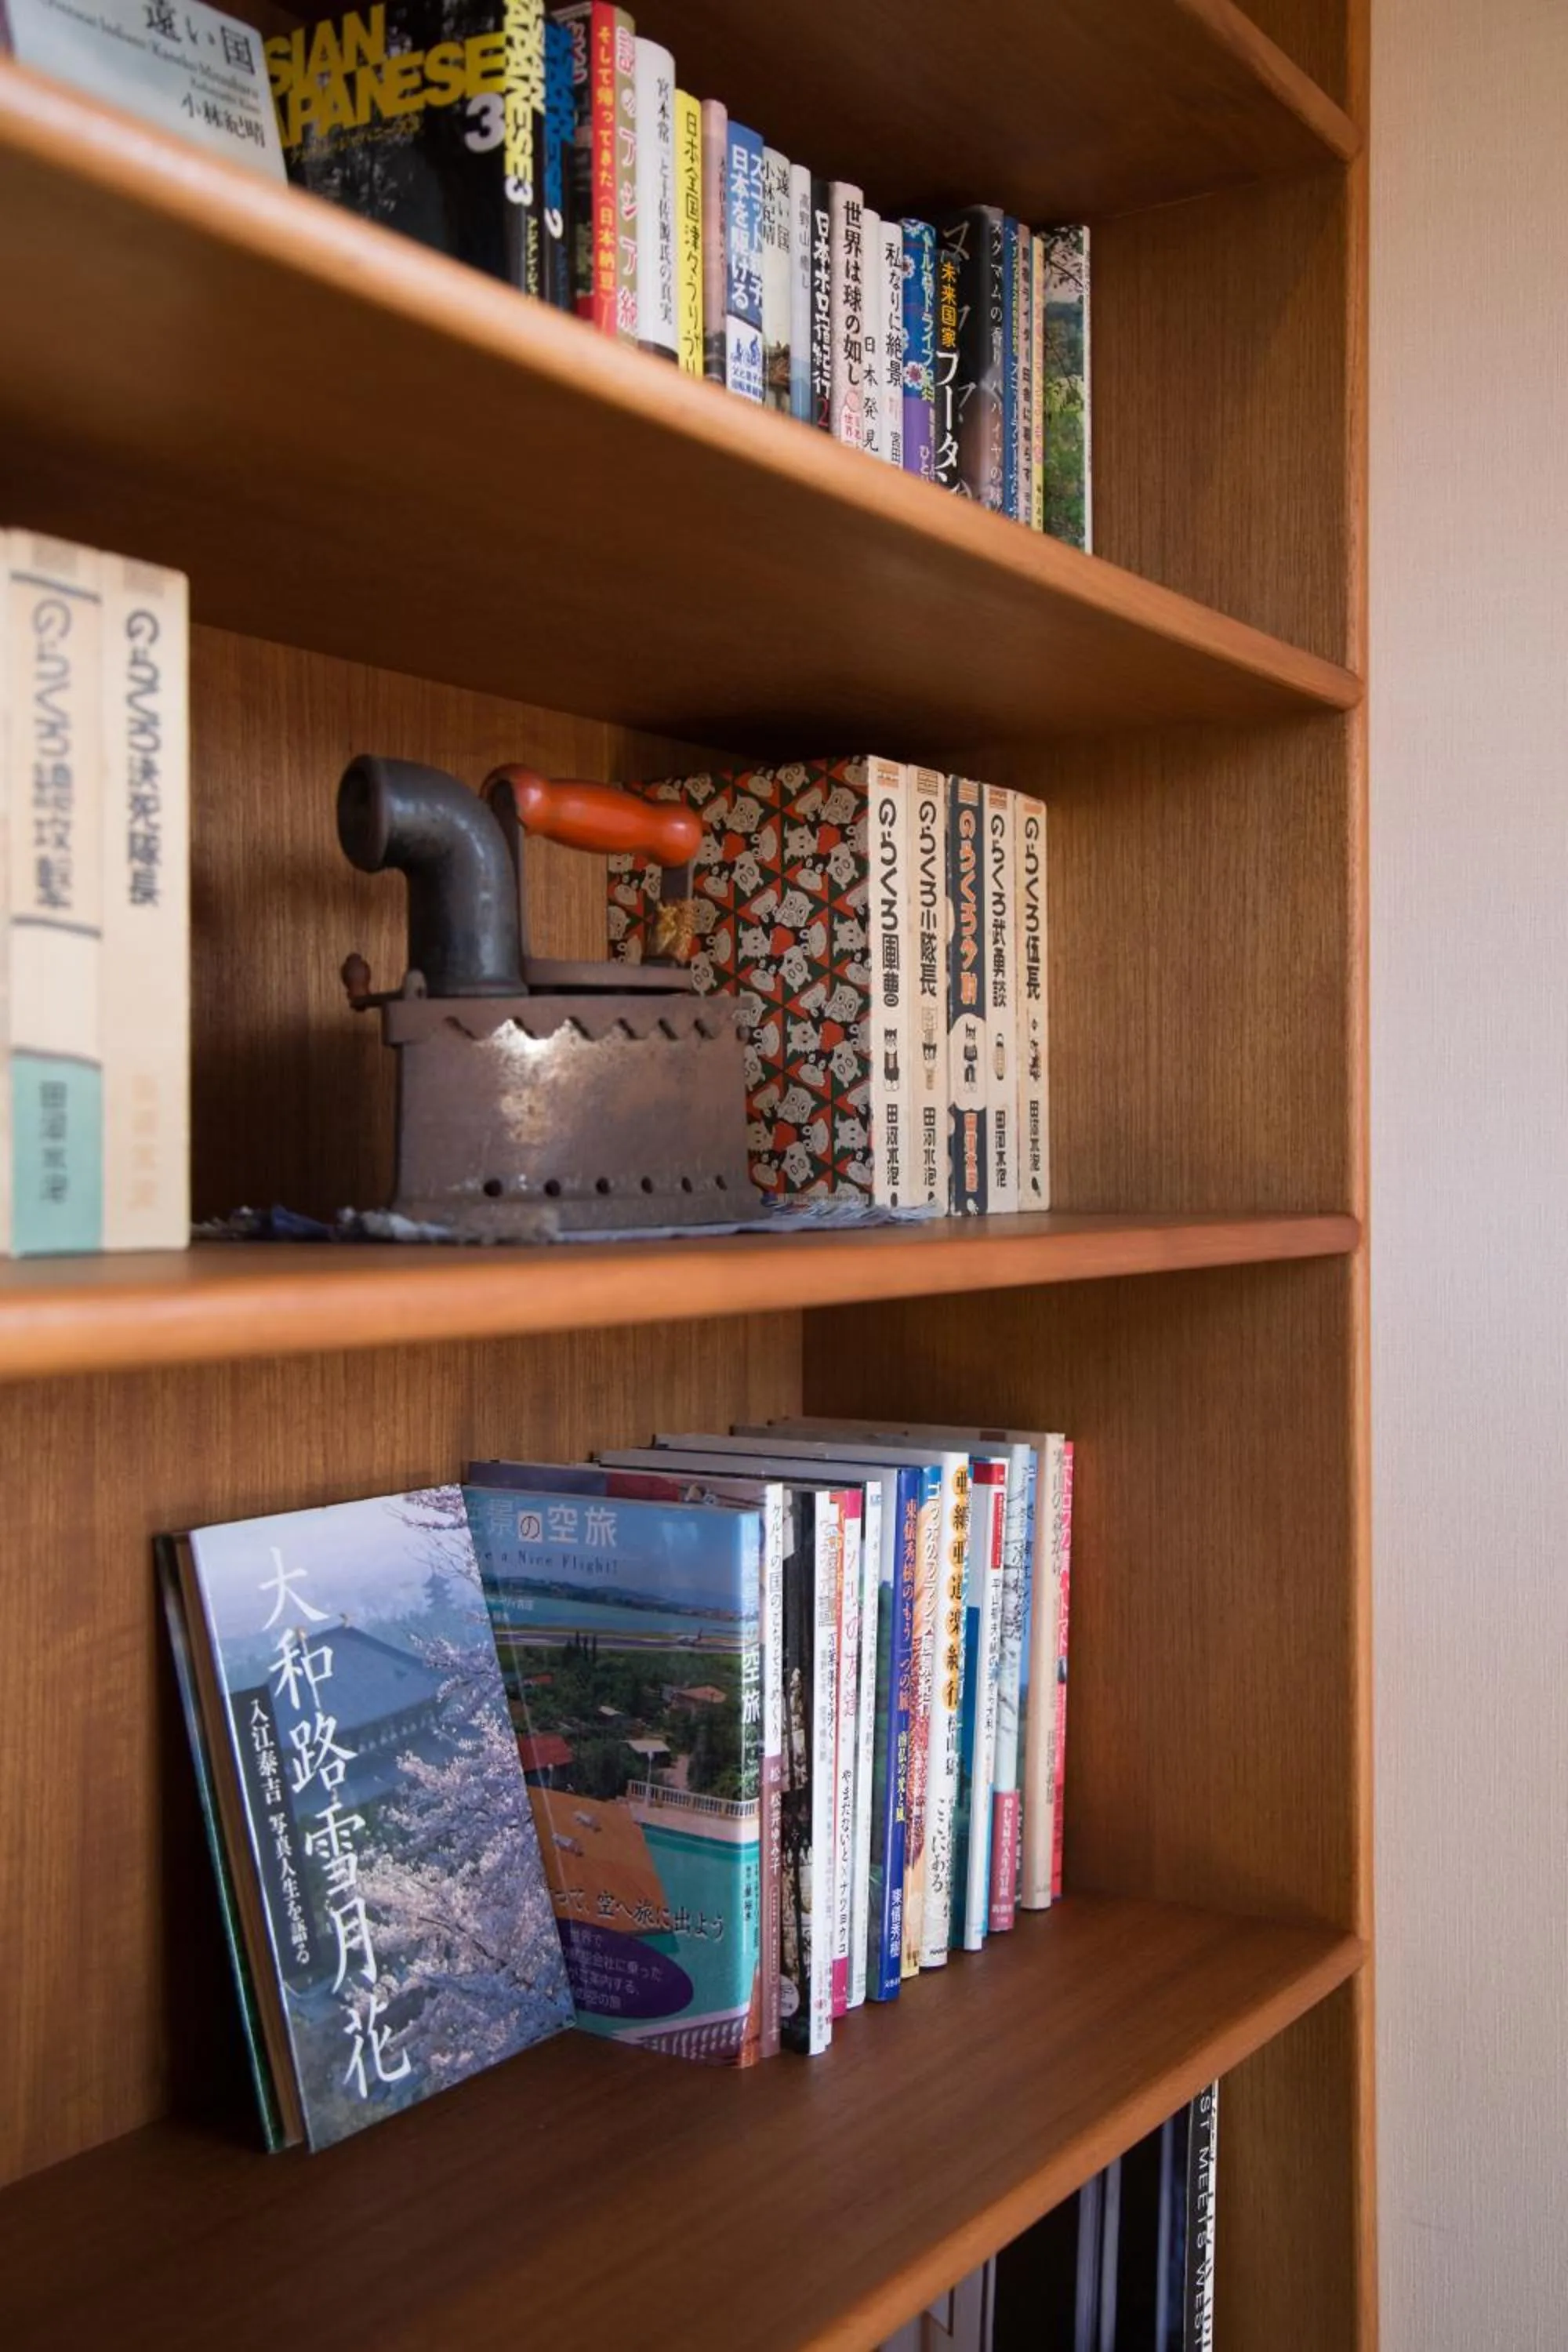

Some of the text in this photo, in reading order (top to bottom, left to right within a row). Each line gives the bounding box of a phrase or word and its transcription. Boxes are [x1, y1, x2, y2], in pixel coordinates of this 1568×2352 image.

[776, 164, 791, 254] 遠い国
[842, 200, 862, 387] 世界は球の如し
[884, 241, 902, 388] 私なりに絶景
[942, 260, 957, 348] 未来国家
[817, 397, 831, 427] 2
[862, 336, 880, 453] 日本発見
[249, 1697, 312, 1965] 入江泰吉 写真人生を語る
[258, 1547, 412, 2100] 大和路雪月花
